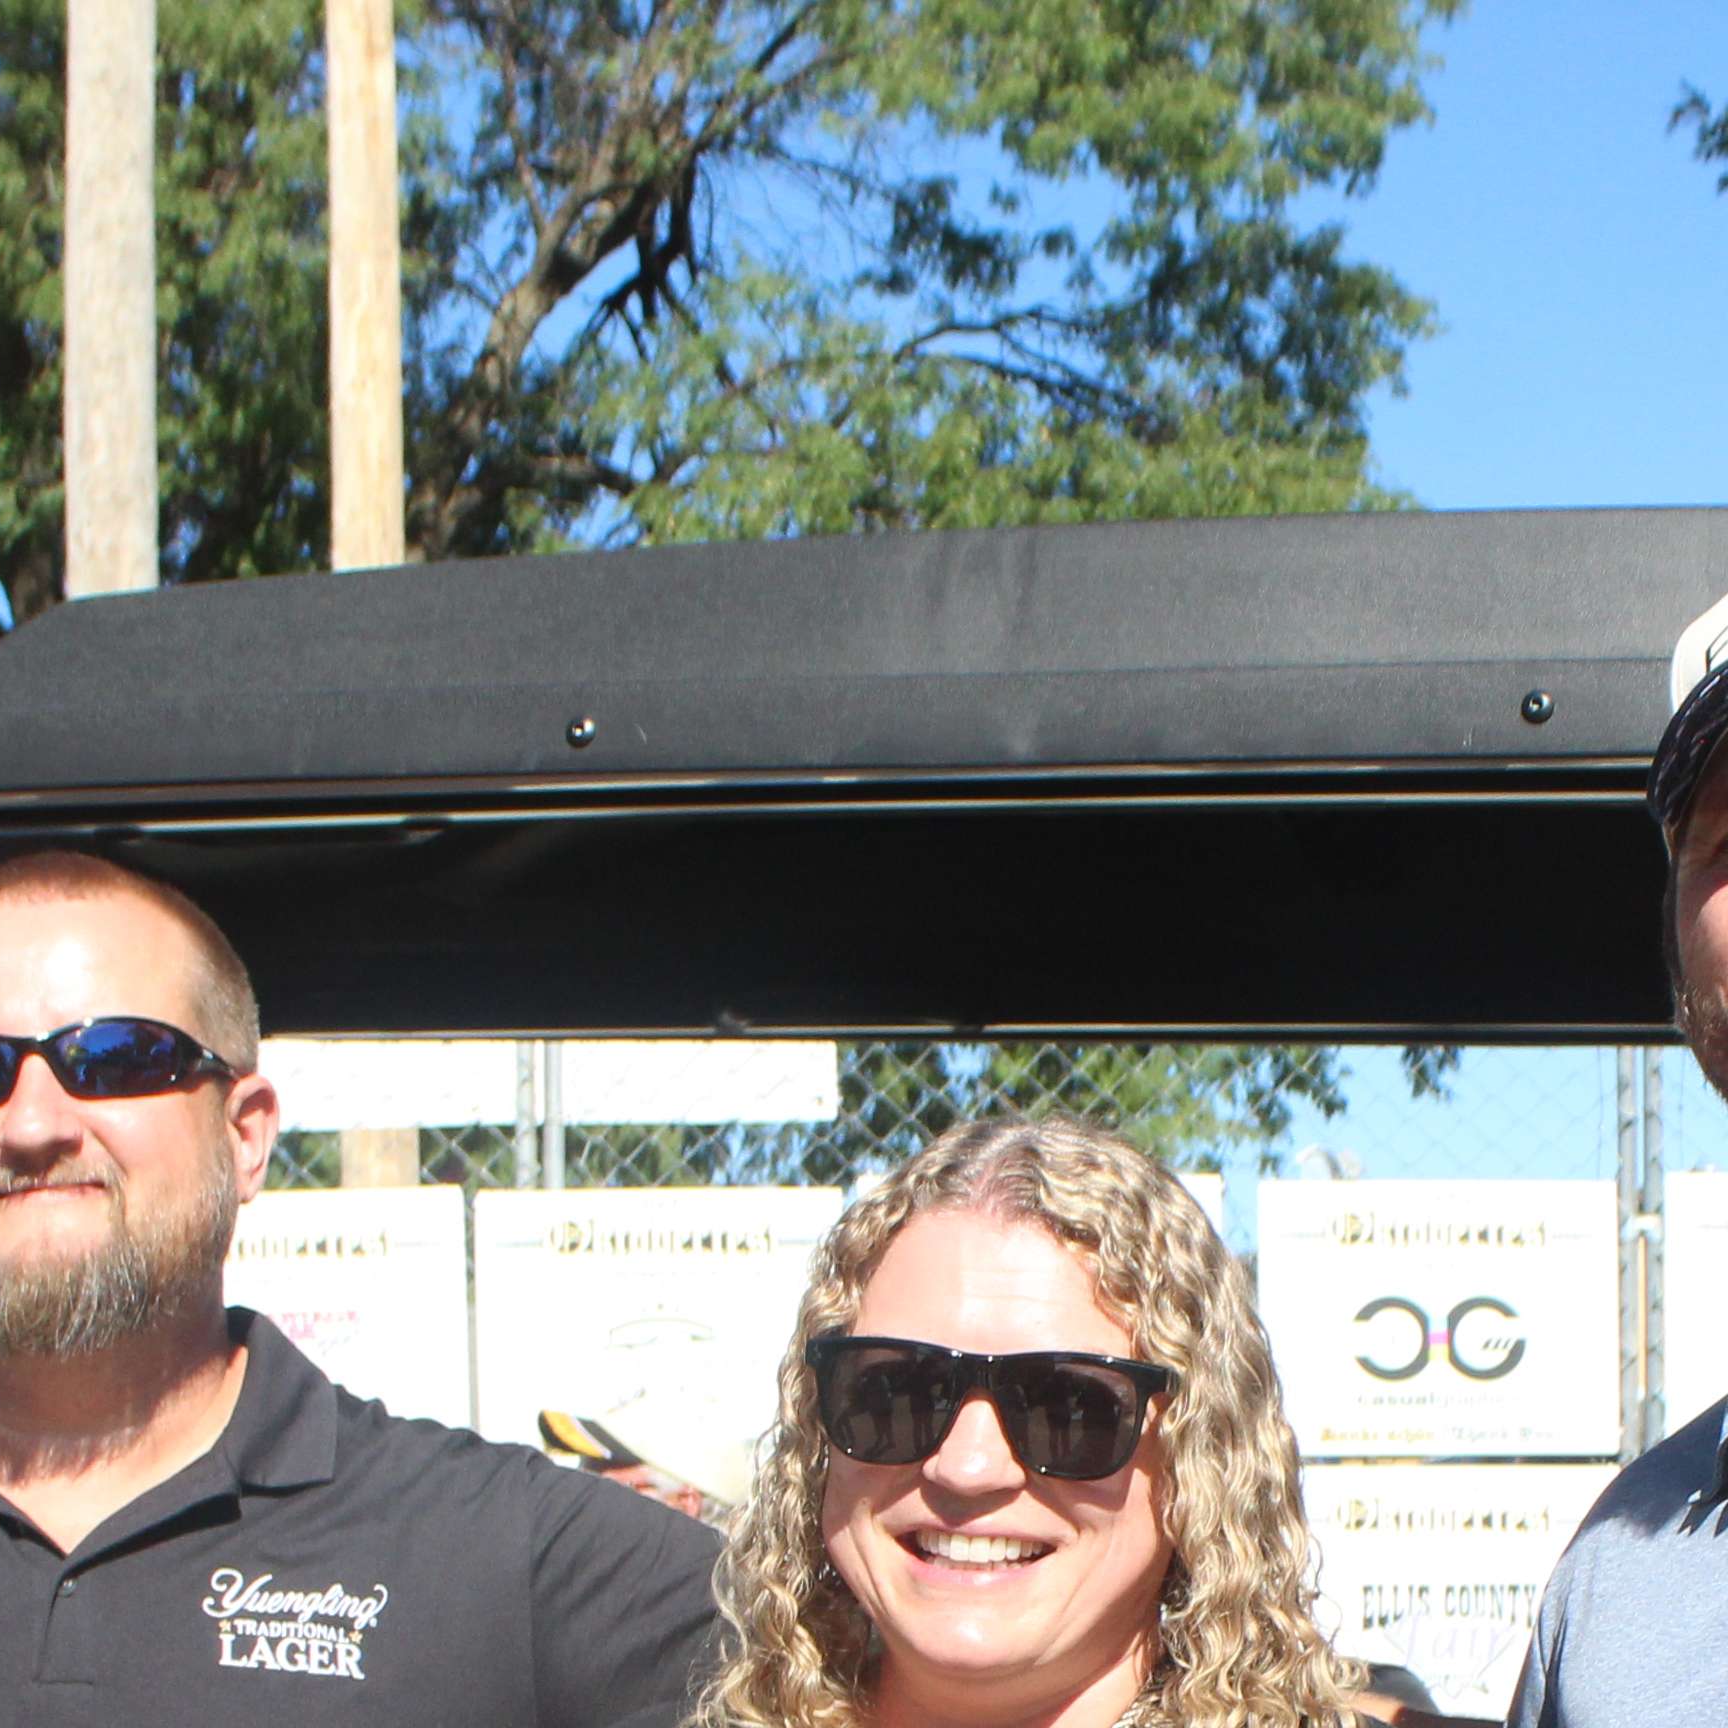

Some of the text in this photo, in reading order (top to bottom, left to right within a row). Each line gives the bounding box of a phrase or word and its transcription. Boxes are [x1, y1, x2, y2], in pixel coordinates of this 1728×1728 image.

[202, 1566, 389, 1629] Yuengling
[1360, 1583, 1537, 1632] ELLIS COUNTY
[233, 1618, 350, 1643] TRADITIONAL
[218, 1632, 365, 1681] LAGER
